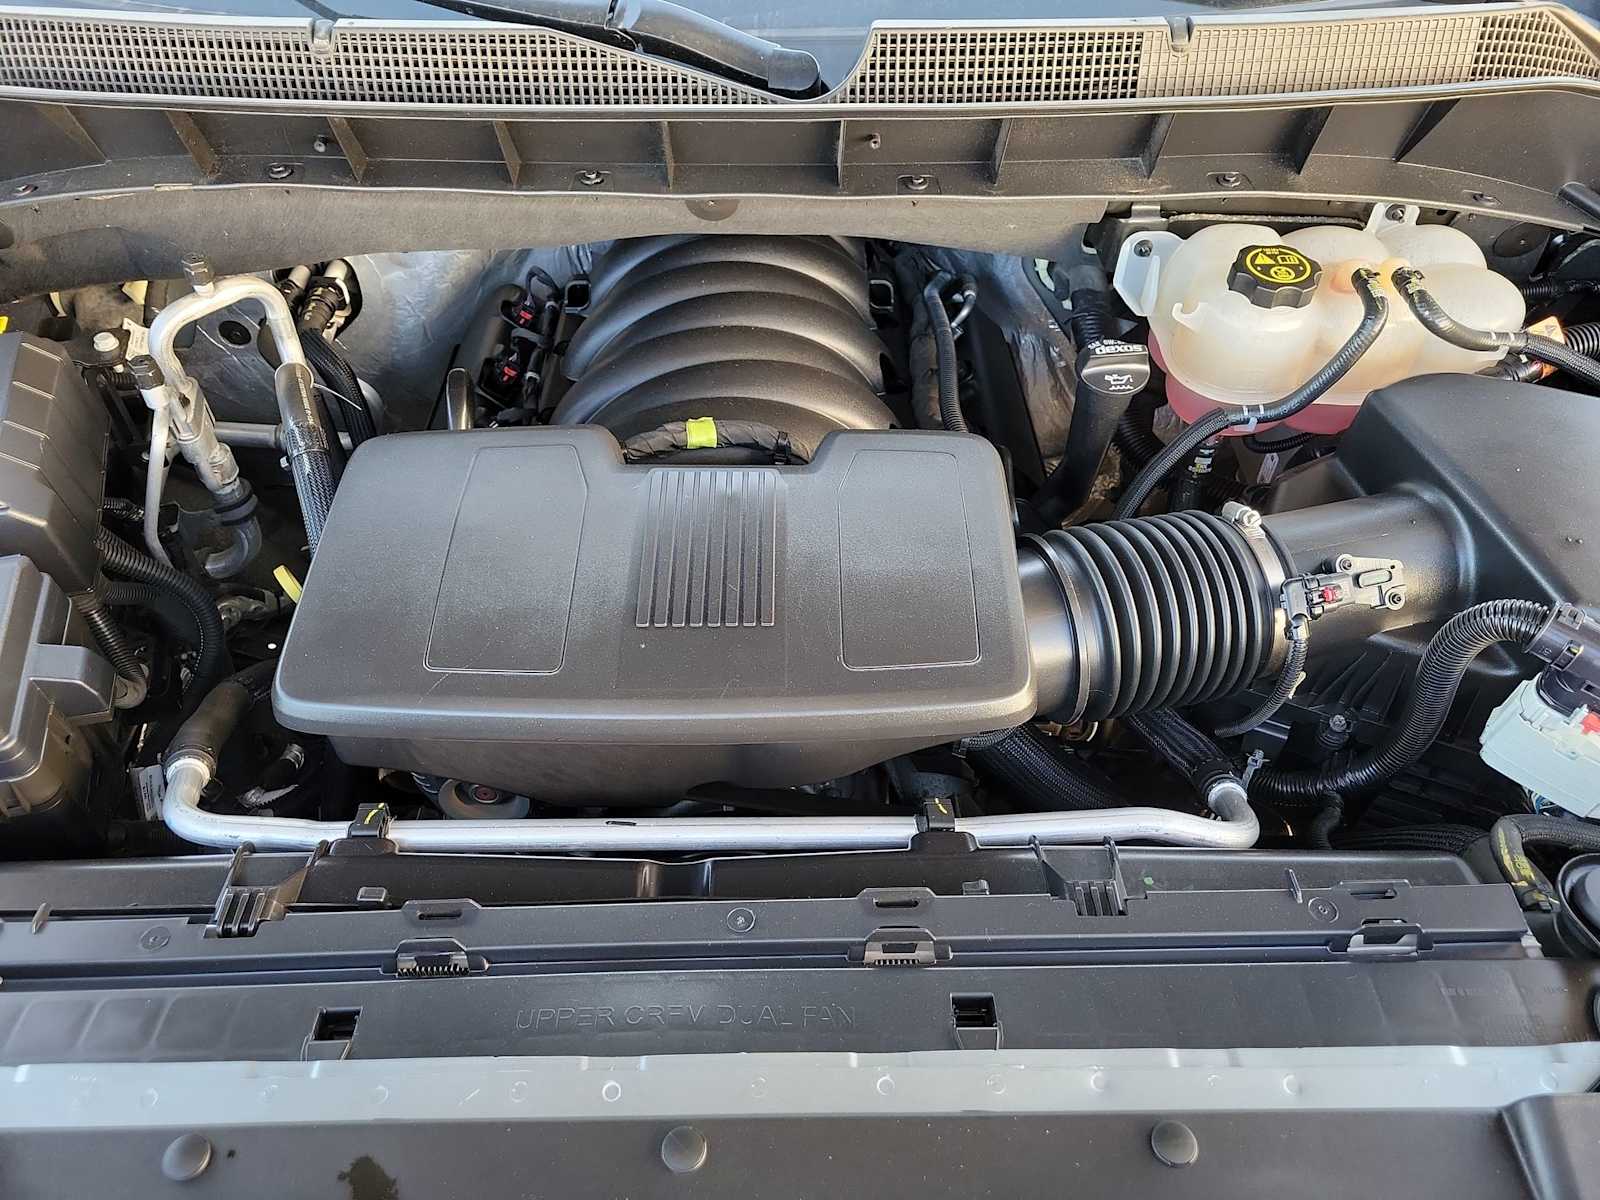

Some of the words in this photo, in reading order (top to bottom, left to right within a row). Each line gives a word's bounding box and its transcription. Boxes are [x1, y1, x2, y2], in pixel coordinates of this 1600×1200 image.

[1094, 344, 1143, 354] dexos
[515, 1006, 615, 1030] UPPER
[716, 1004, 793, 1025] DUAL
[801, 1004, 856, 1028] FAN
